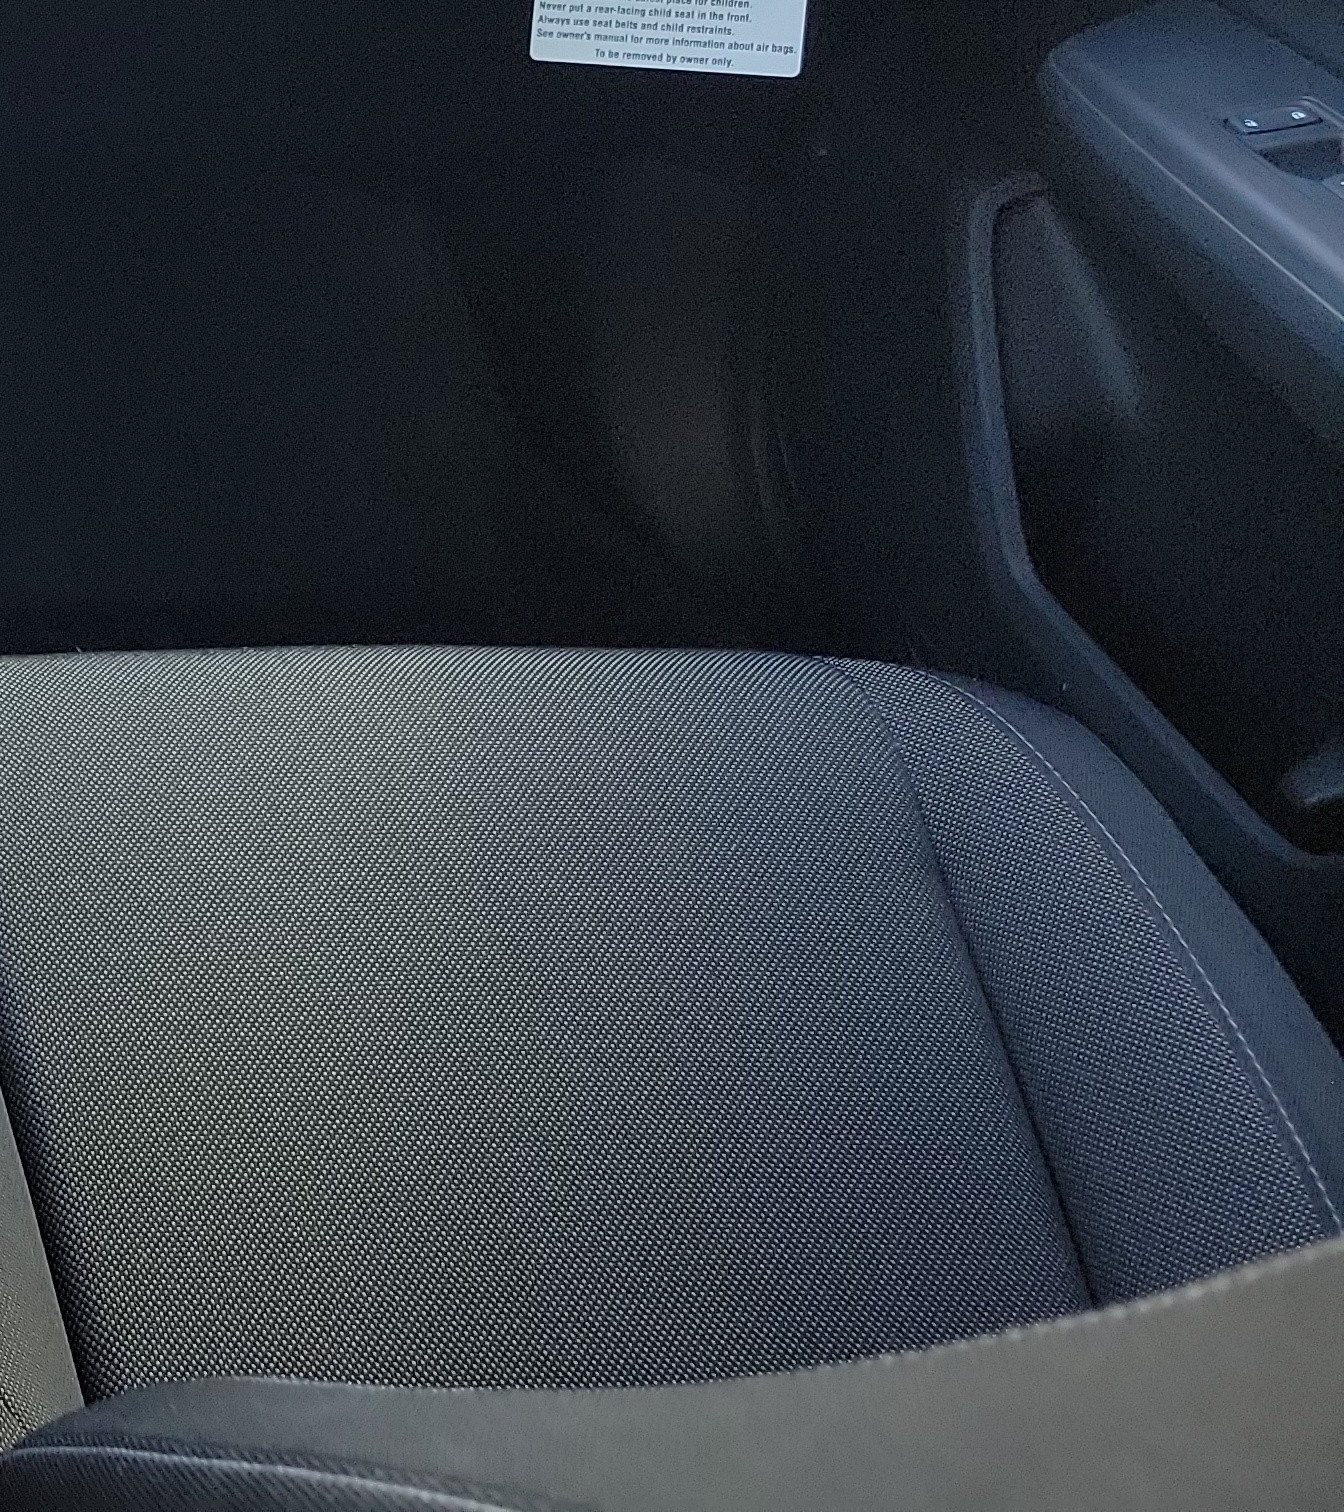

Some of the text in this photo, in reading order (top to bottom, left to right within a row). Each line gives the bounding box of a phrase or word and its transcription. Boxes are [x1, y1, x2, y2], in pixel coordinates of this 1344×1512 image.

[539, 1, 566, 11] Never
[569, 3, 584, 13] put
[595, 5, 646, 17] rear-facing
[648, 7, 672, 18] child
[674, 10, 695, 19] seat
[697, 10, 706, 19] in
[709, 10, 724, 21] the
[727, 12, 752, 23] front.
[537, 15, 734, 36] Always use seat belts and child restraints.
[536, 28, 797, 55] See owner's manual for more information about air bags.
[595, 48, 734, 68] To be removed by owner only.
